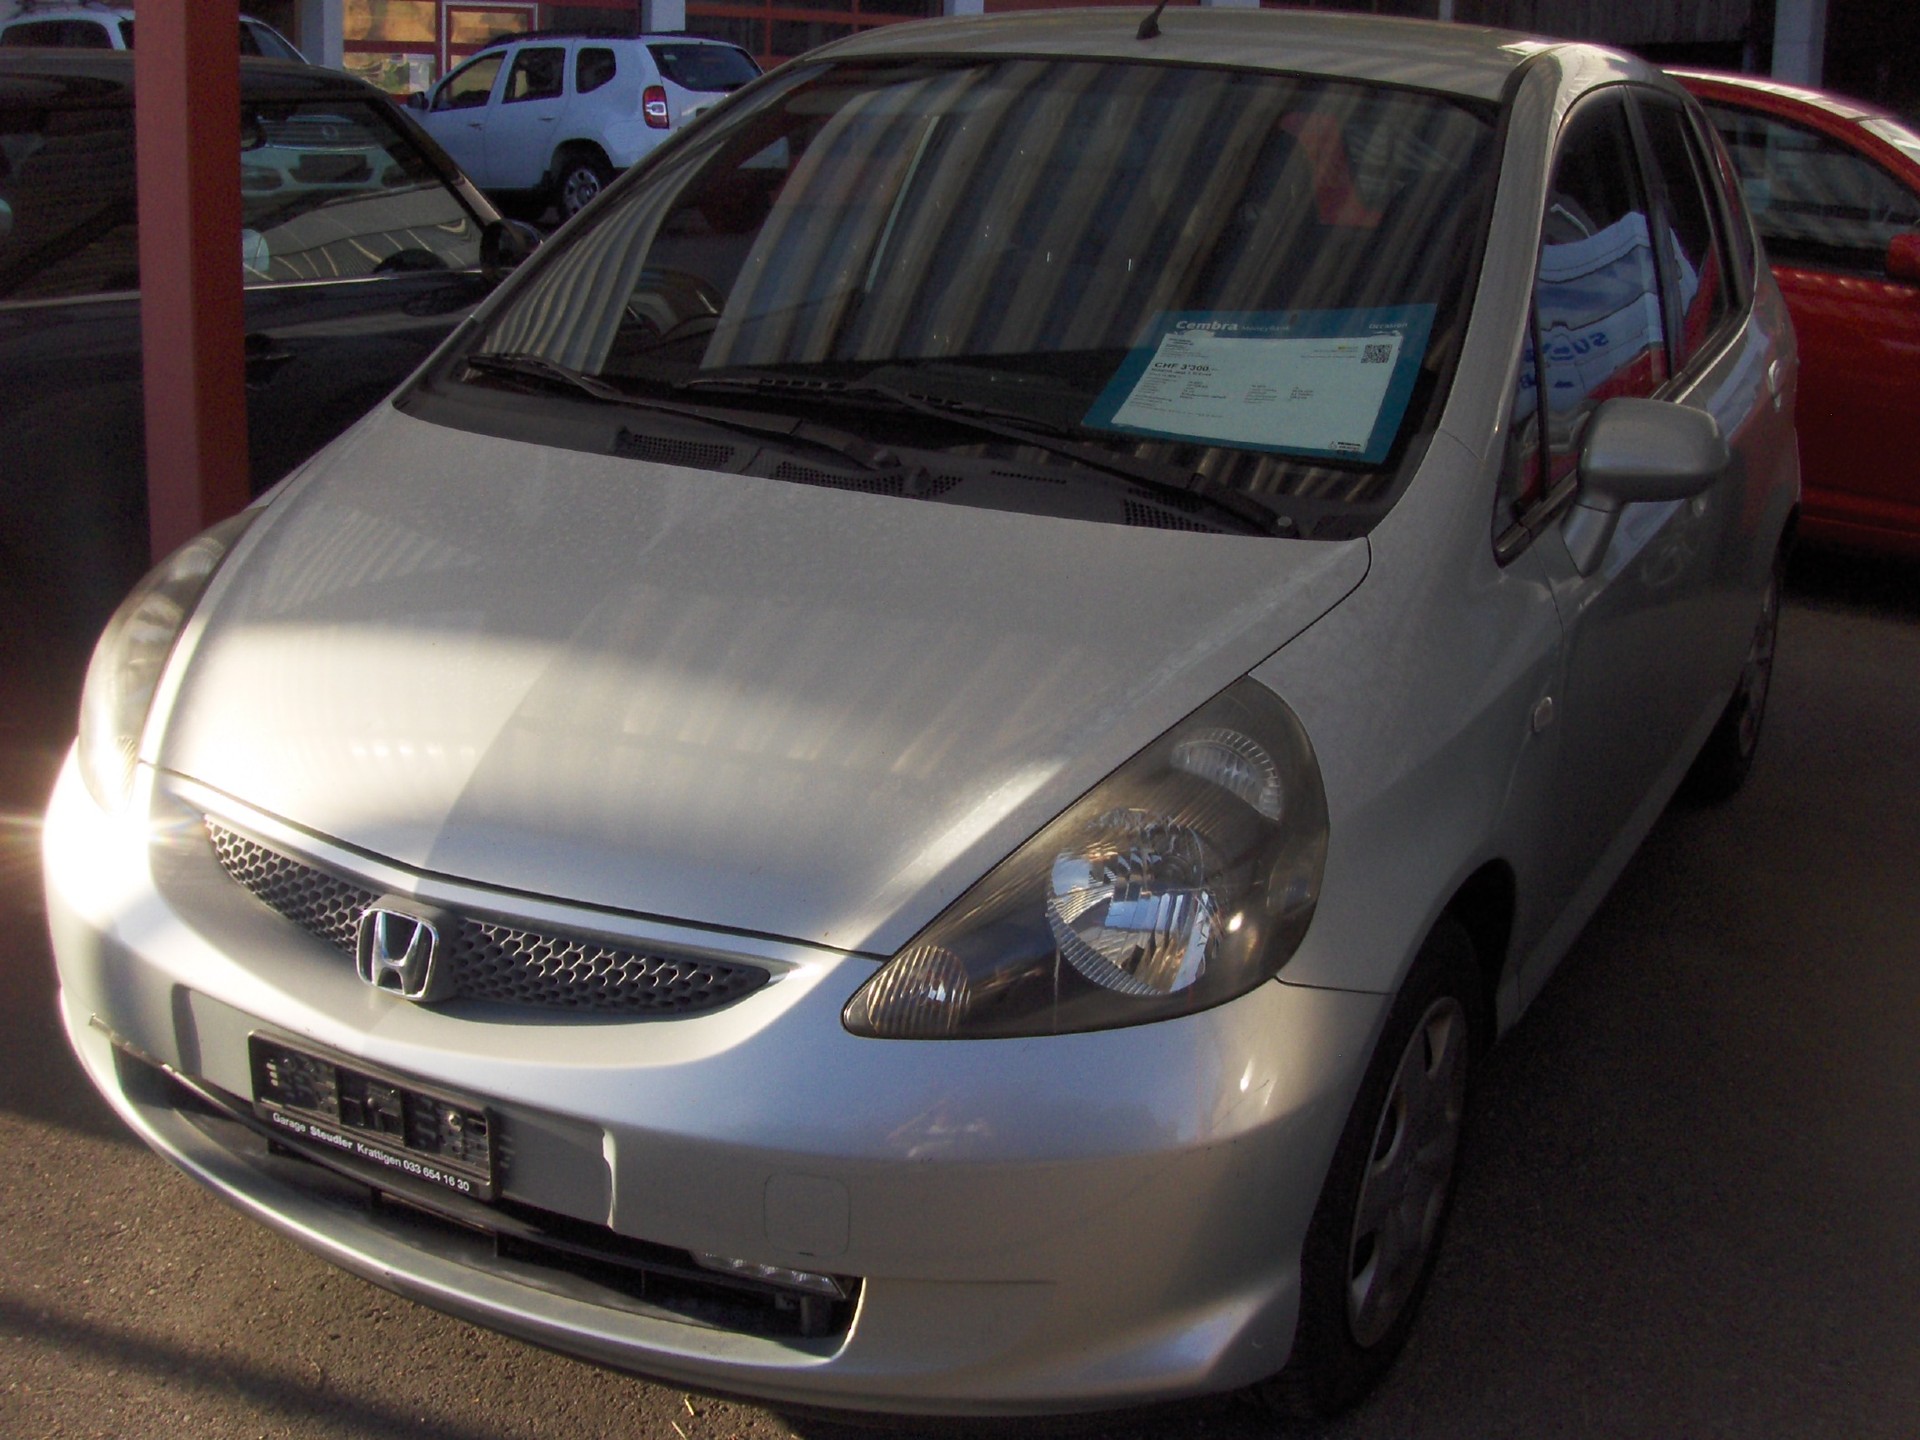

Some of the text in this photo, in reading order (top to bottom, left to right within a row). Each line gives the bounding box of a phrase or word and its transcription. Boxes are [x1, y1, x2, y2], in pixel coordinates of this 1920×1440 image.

[1176, 320, 1239, 331] Cembra
[1368, 322, 1408, 330] Occasion
[272, 1112, 470, 1192] Garage Steudler Krattigen 033 654 16 30
